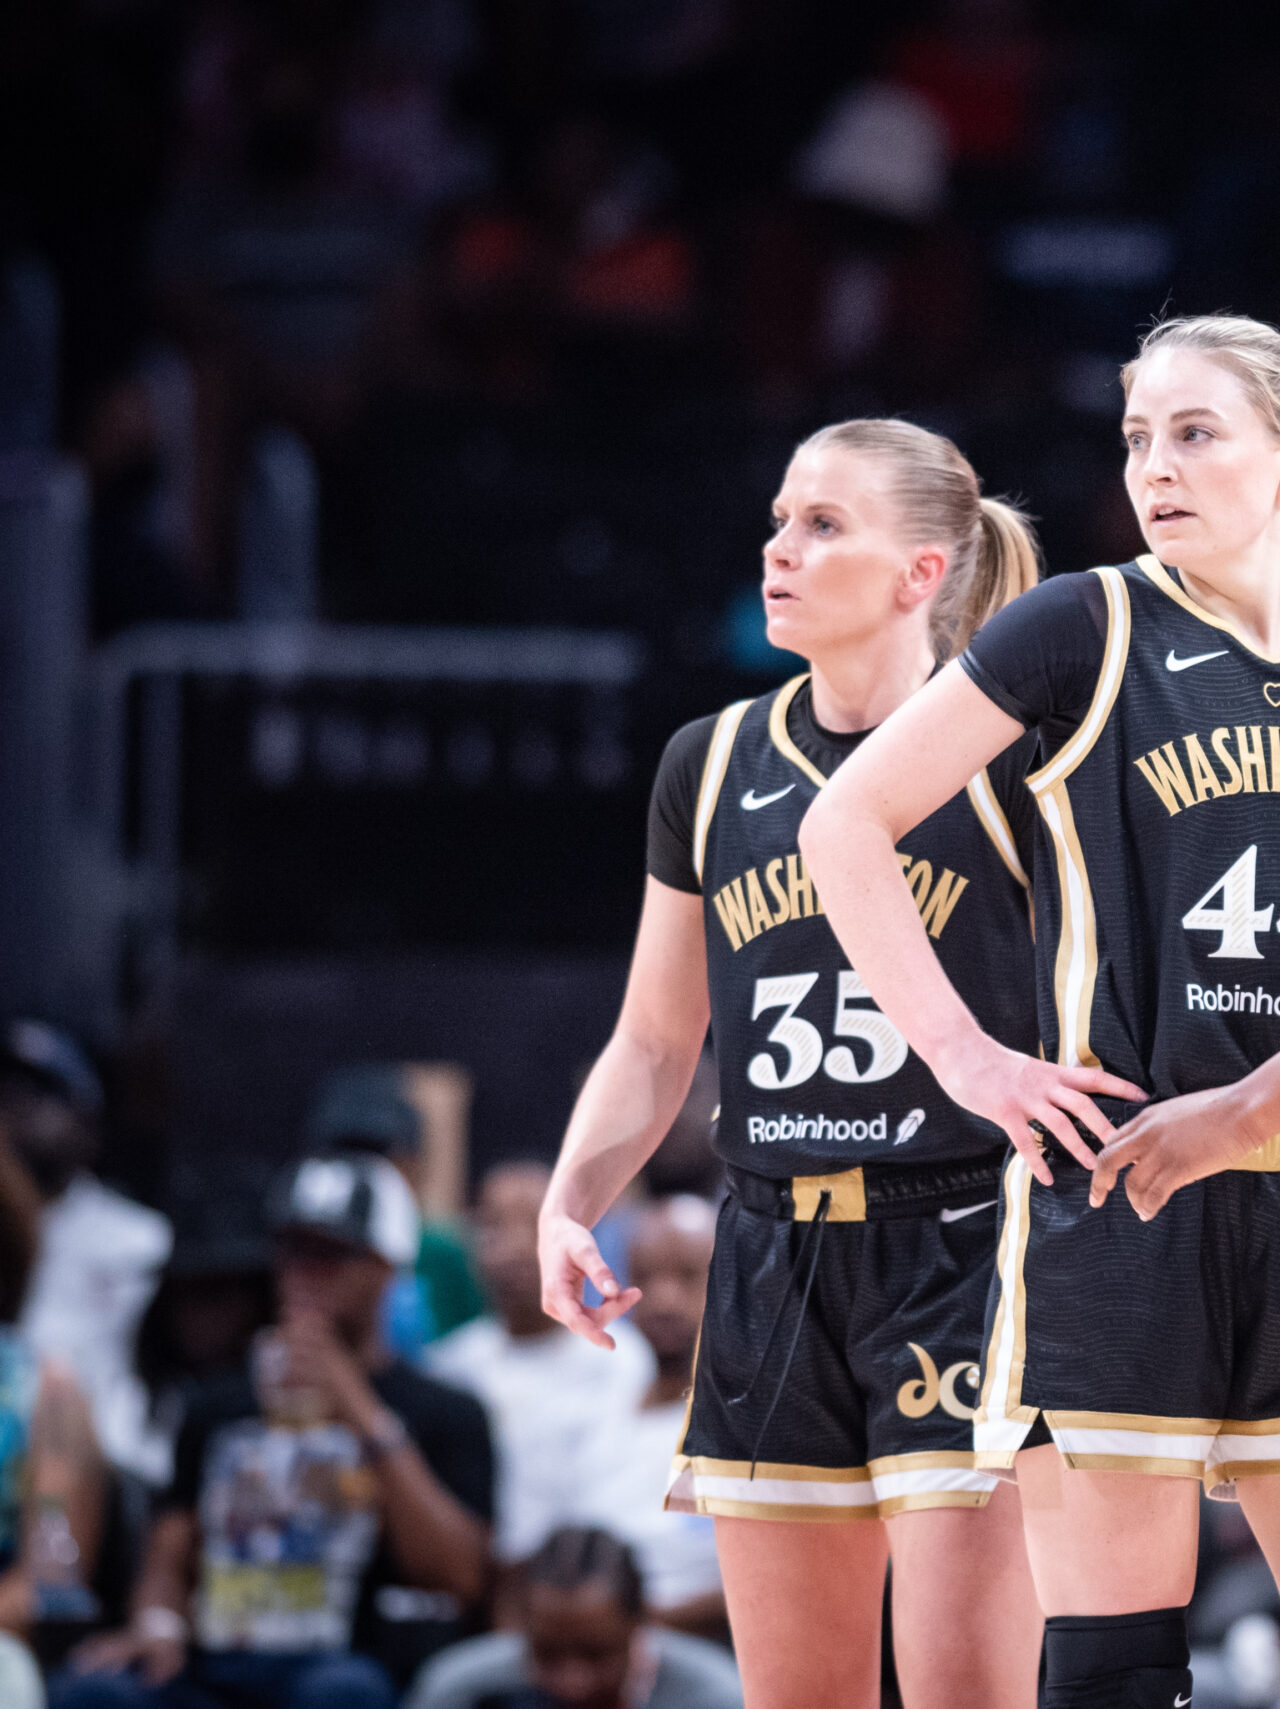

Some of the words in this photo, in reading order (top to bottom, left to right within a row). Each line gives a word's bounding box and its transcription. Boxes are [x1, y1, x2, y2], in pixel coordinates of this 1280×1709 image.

[713, 853, 969, 952] WASHON
[747, 970, 908, 1089] 35
[748, 1113, 888, 1143] Robinhood
